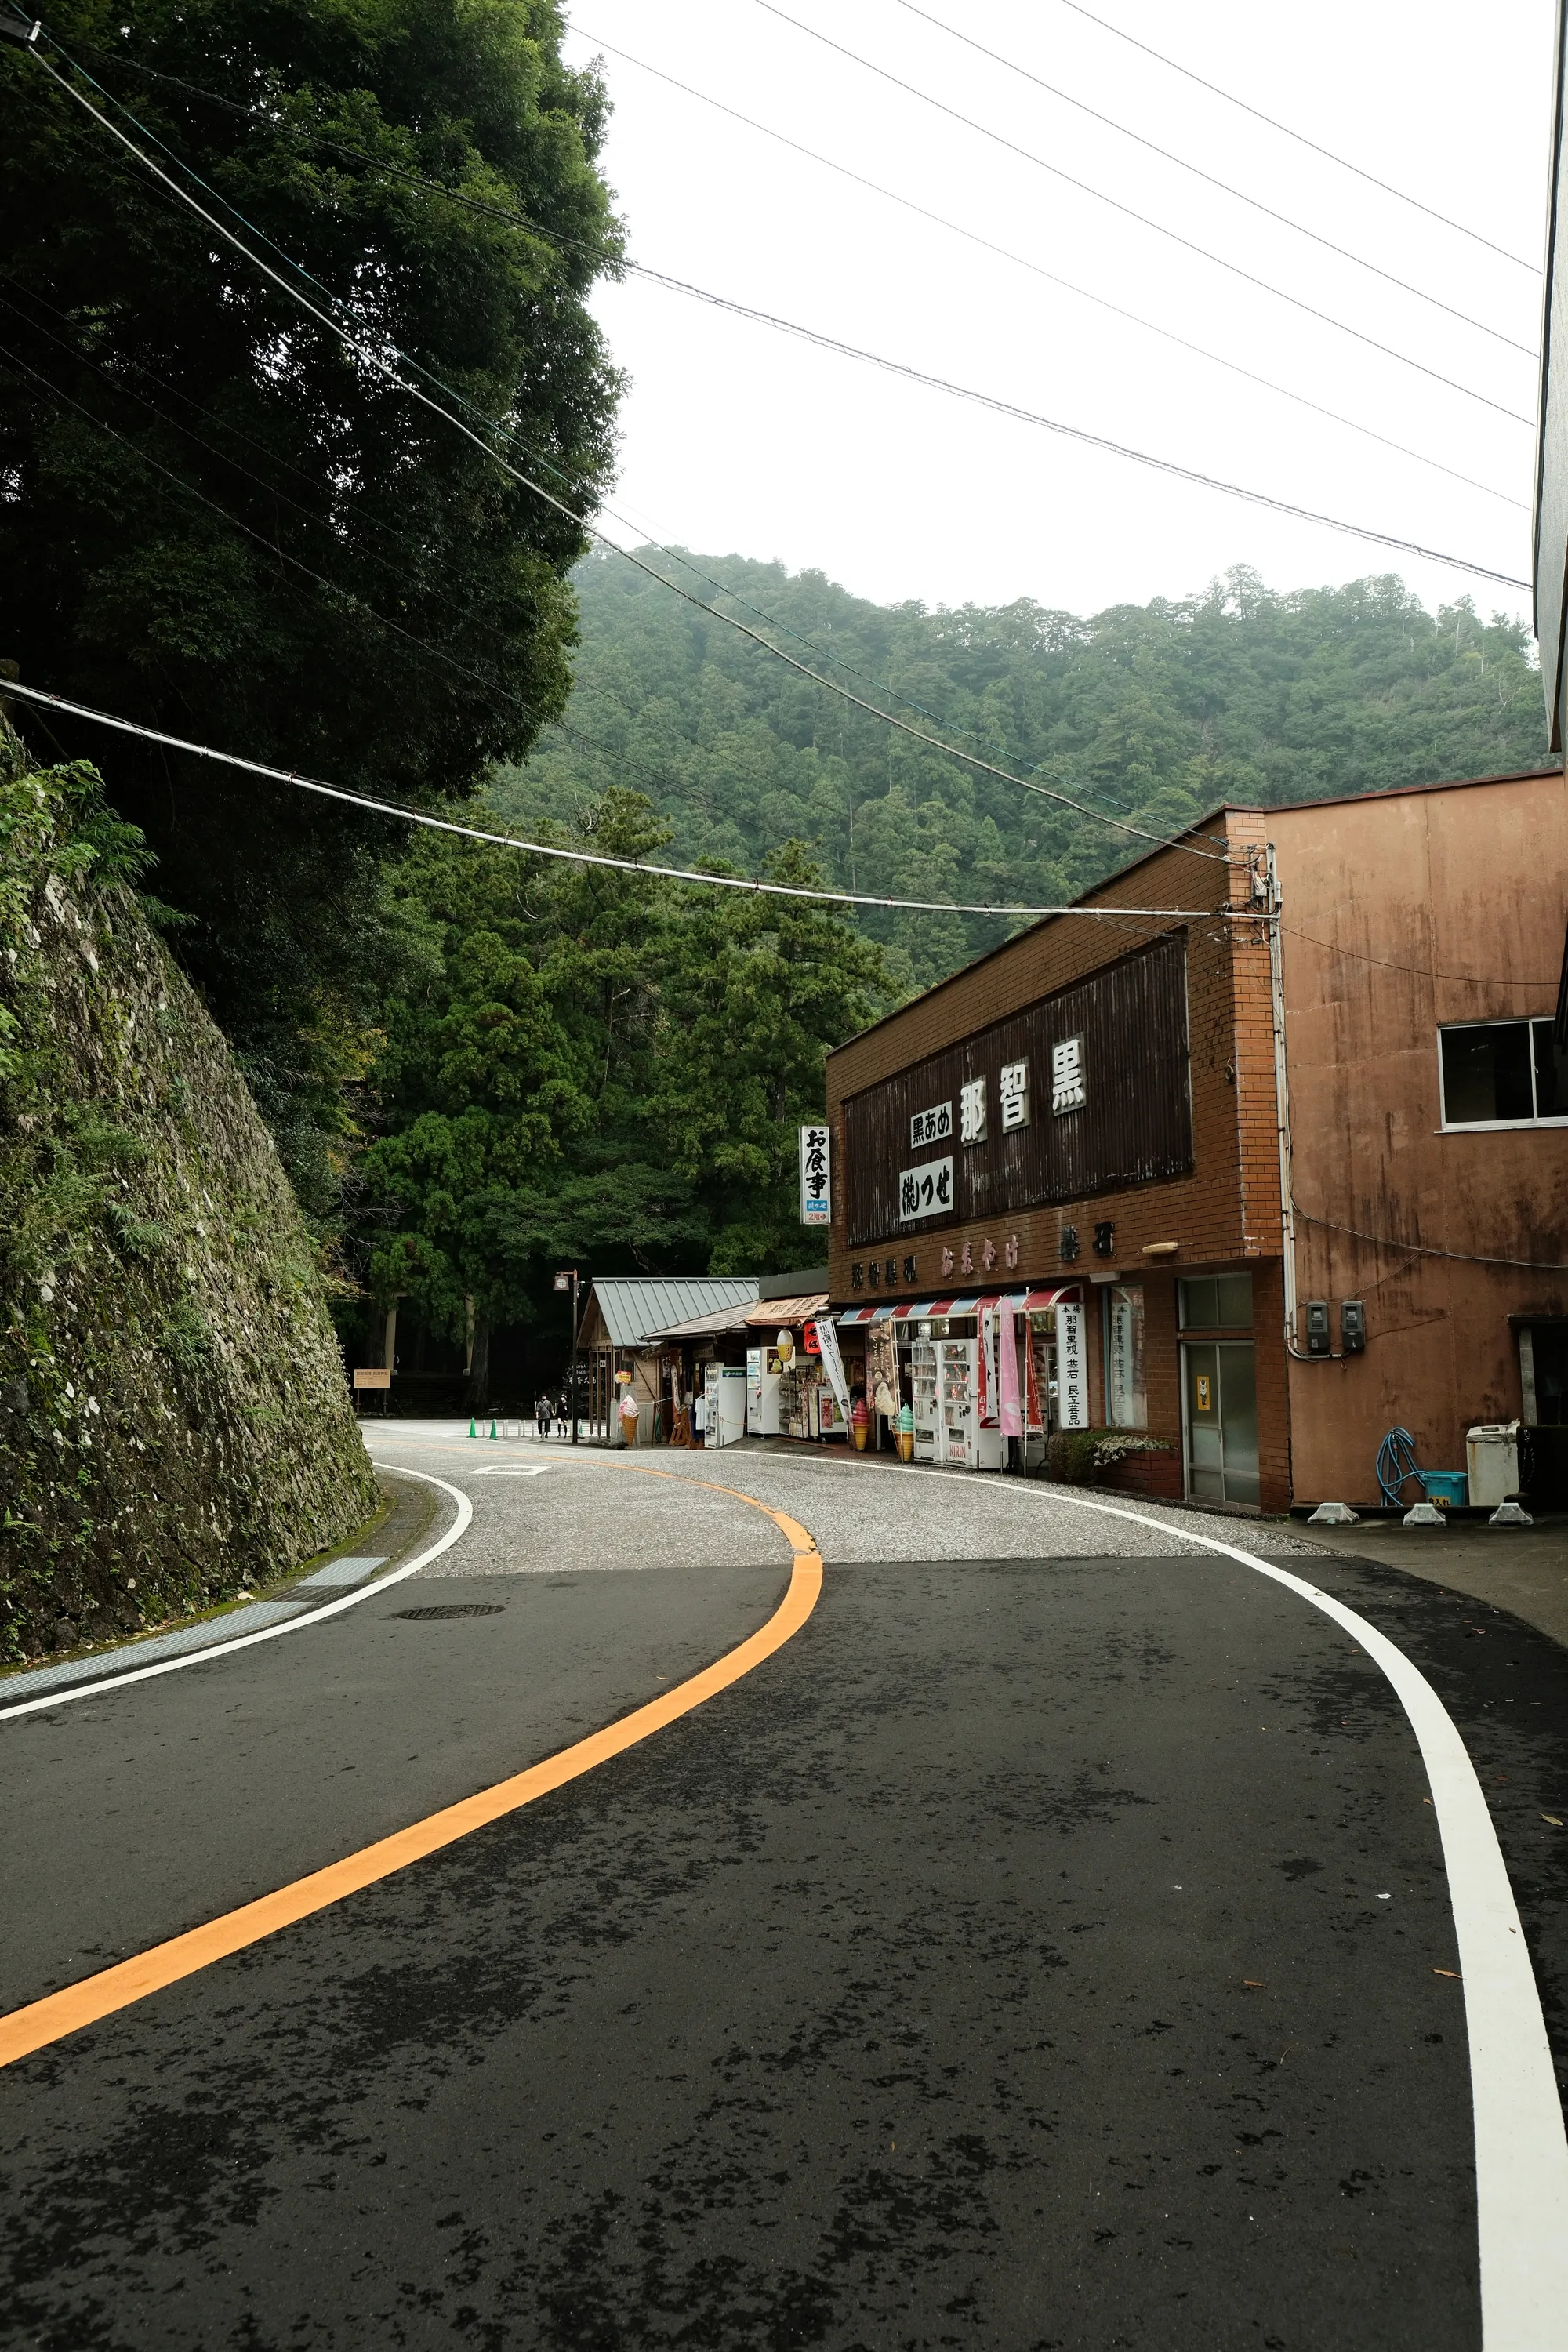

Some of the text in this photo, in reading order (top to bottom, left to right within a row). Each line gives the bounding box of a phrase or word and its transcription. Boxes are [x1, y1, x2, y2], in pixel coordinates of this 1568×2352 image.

[960, 1039, 1083, 1142] 那智黒
[913, 1105, 949, 1145] 黒あめ
[805, 1130, 828, 1199] お食事
[1065, 1315, 1079, 1356] 那智黒硯
[1068, 1385, 1080, 1425] 民工芸品
[949, 1445, 966, 1458] KIRIN
